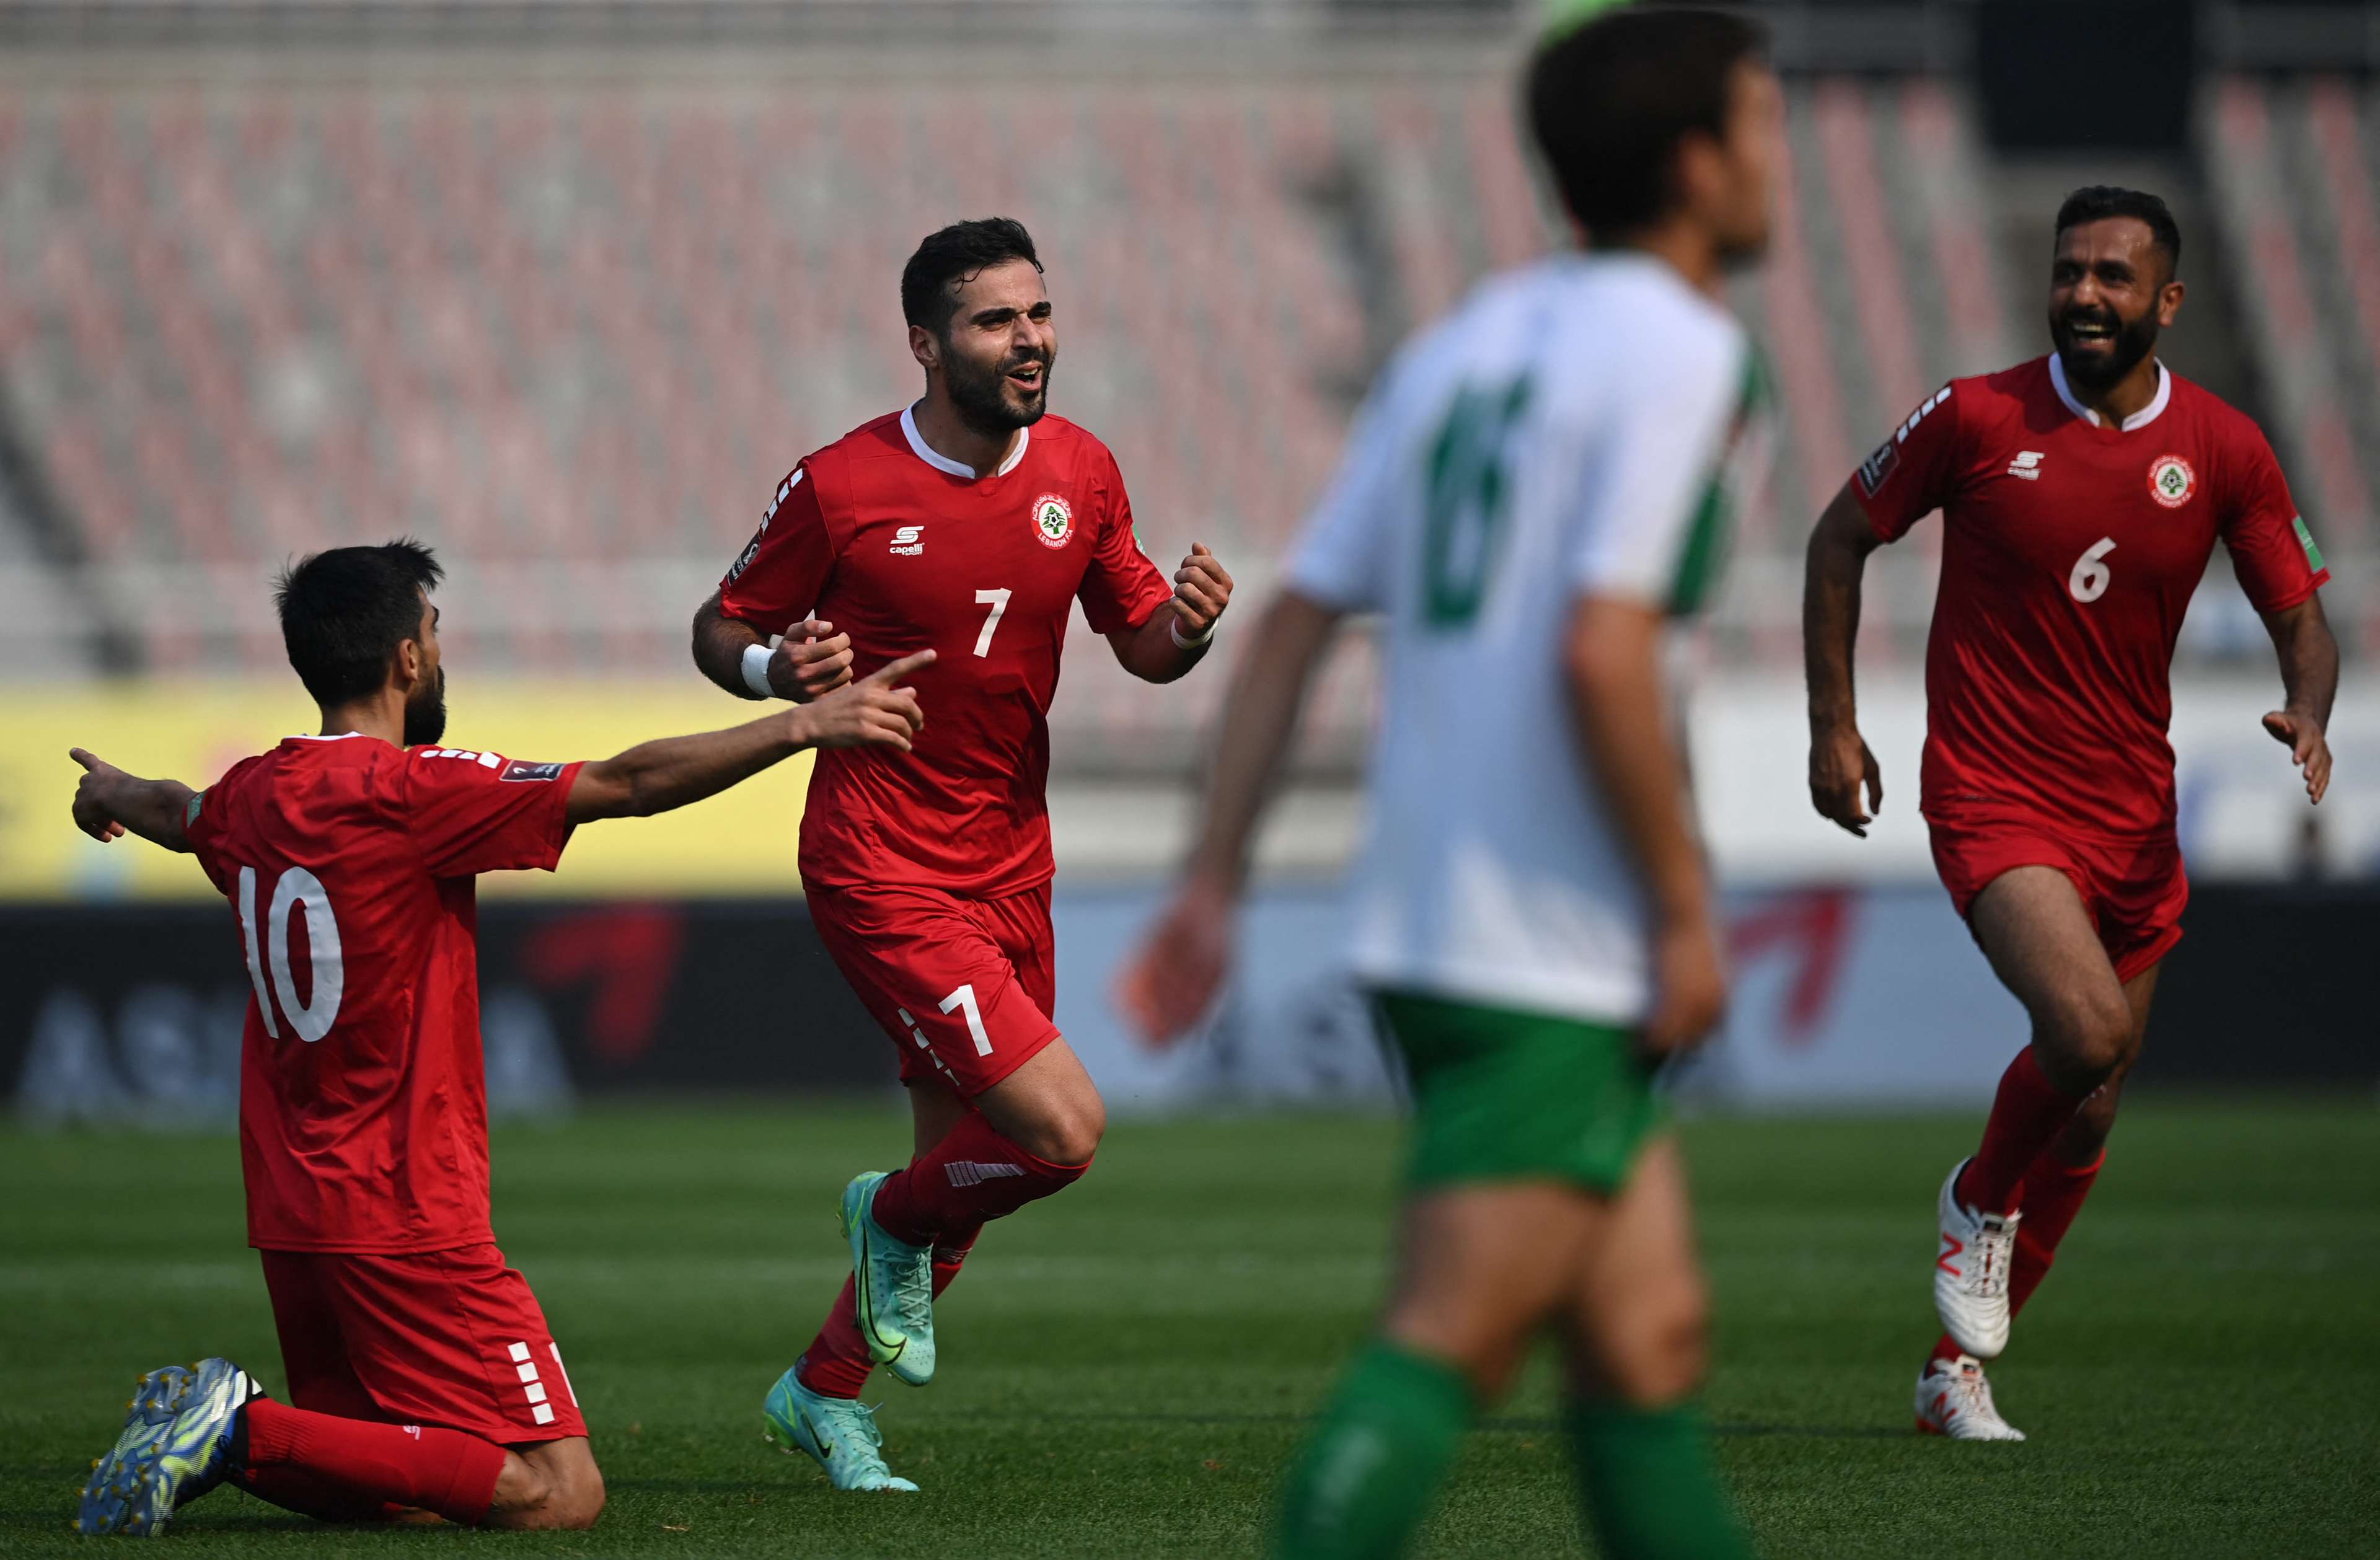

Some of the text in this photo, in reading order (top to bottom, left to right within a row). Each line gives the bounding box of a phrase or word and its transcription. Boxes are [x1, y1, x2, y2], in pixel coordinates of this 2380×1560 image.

[889, 543, 923, 555] capelli
[1038, 532, 1067, 548] LEBANON
[2069, 535, 2117, 603] 6
[972, 588, 1012, 658] 7
[239, 865, 344, 1042] 10
[938, 984, 994, 1057] 7
